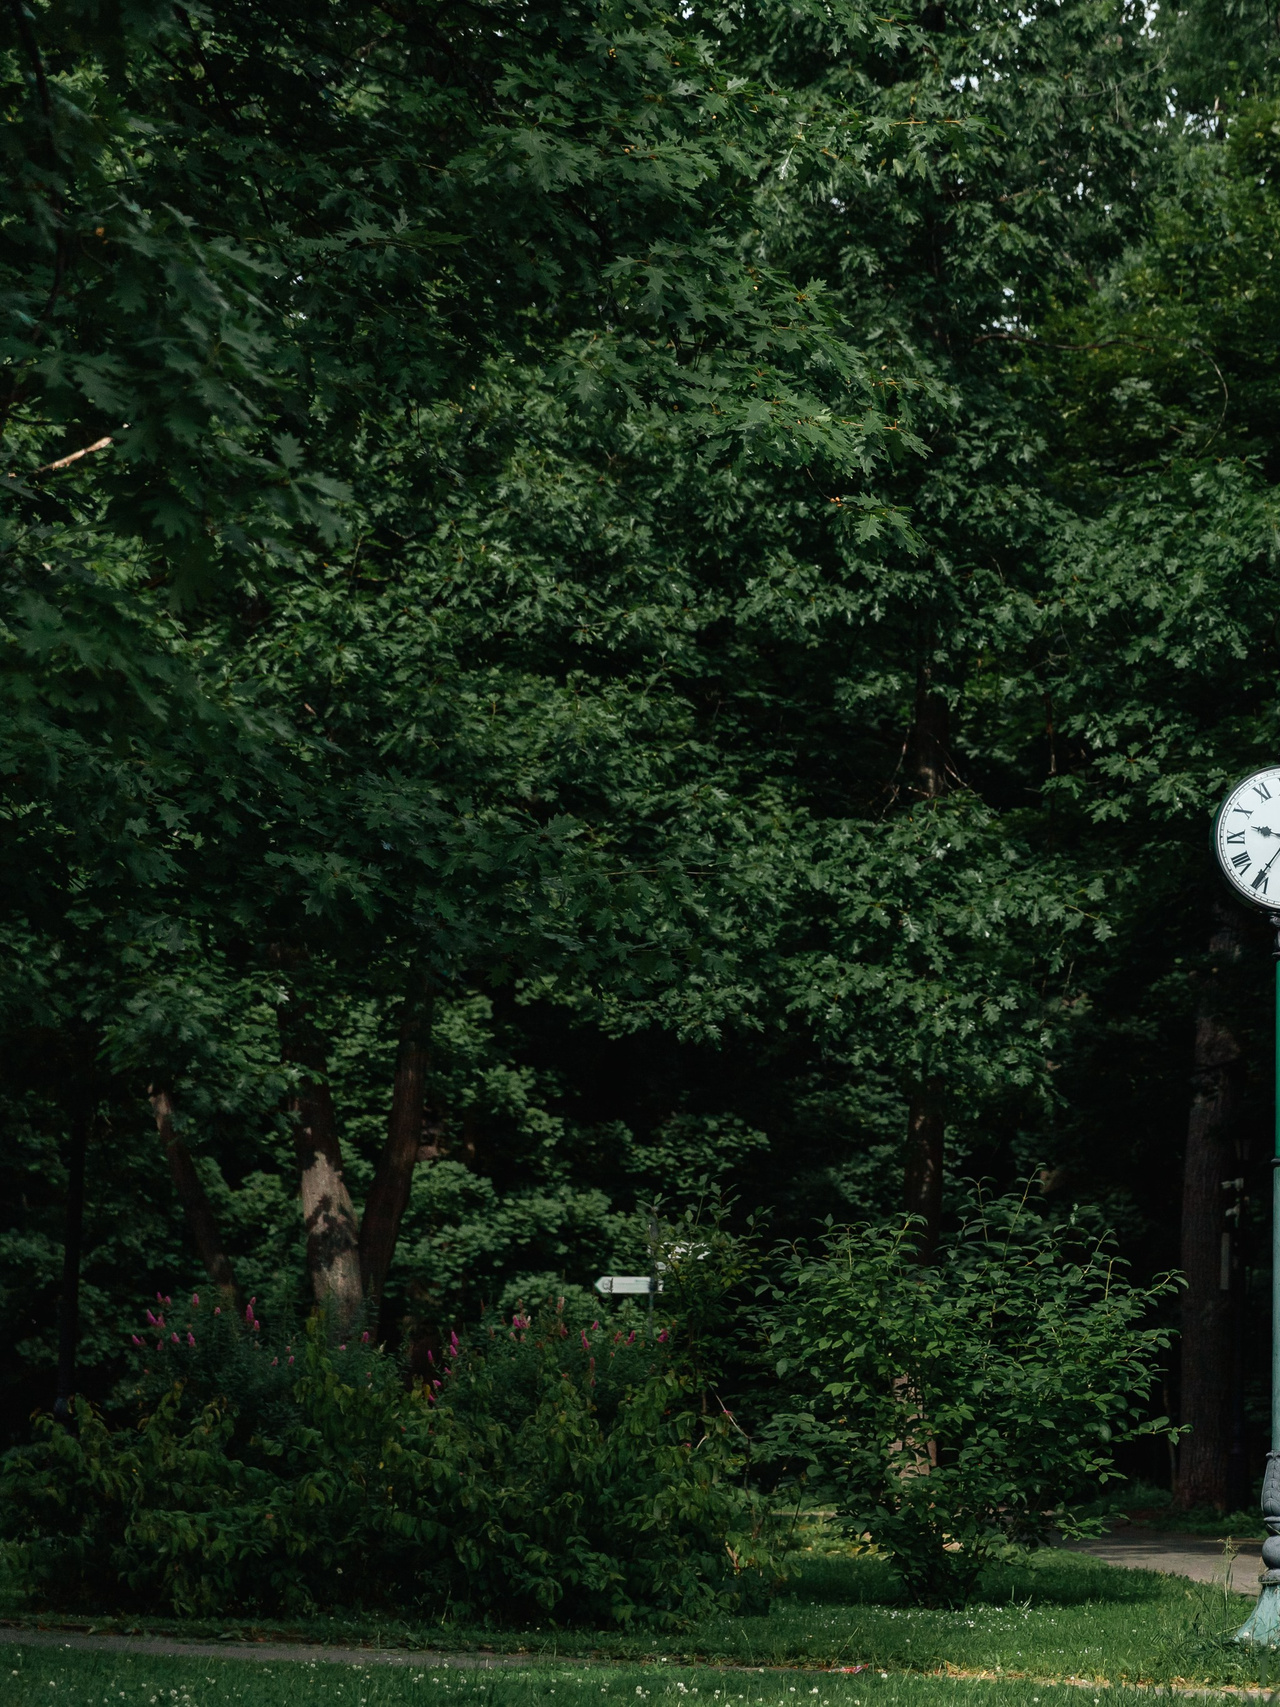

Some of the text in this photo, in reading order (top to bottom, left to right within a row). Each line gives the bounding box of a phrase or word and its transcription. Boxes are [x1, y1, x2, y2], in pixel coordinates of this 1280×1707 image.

[1252, 783, 1273, 803] XI
[1232, 802, 1254, 819] X
[1227, 830, 1245, 844] IX
[1231, 851, 1252, 877] VIII
